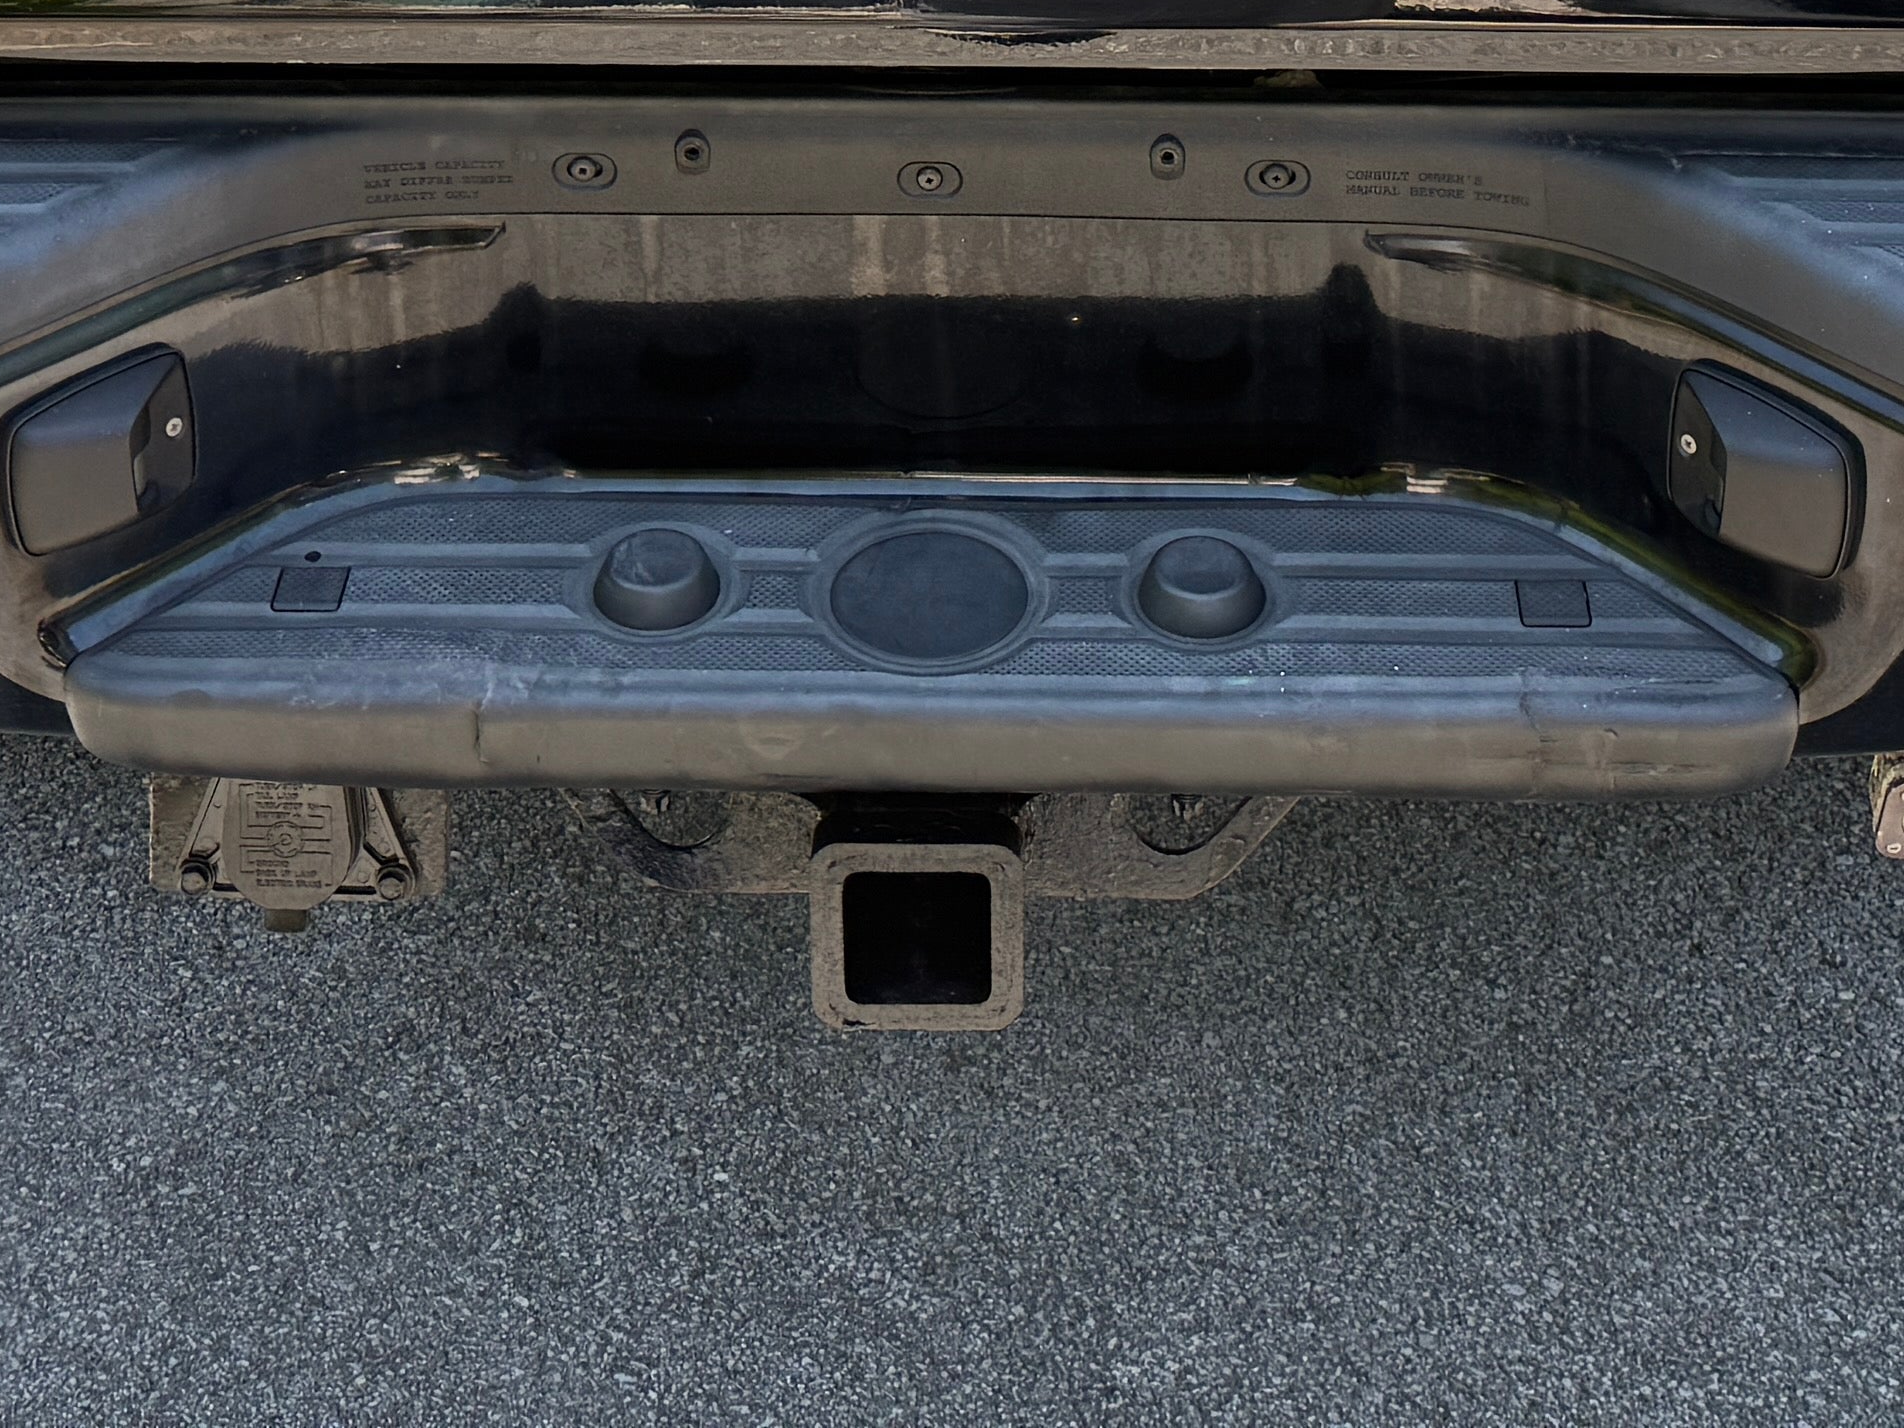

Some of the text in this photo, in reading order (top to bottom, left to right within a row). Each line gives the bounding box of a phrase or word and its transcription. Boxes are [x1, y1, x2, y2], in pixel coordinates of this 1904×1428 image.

[1345, 170, 1410, 182] CONSULT
[1346, 184, 1531, 207] MANUAL BEFORE TOWING
